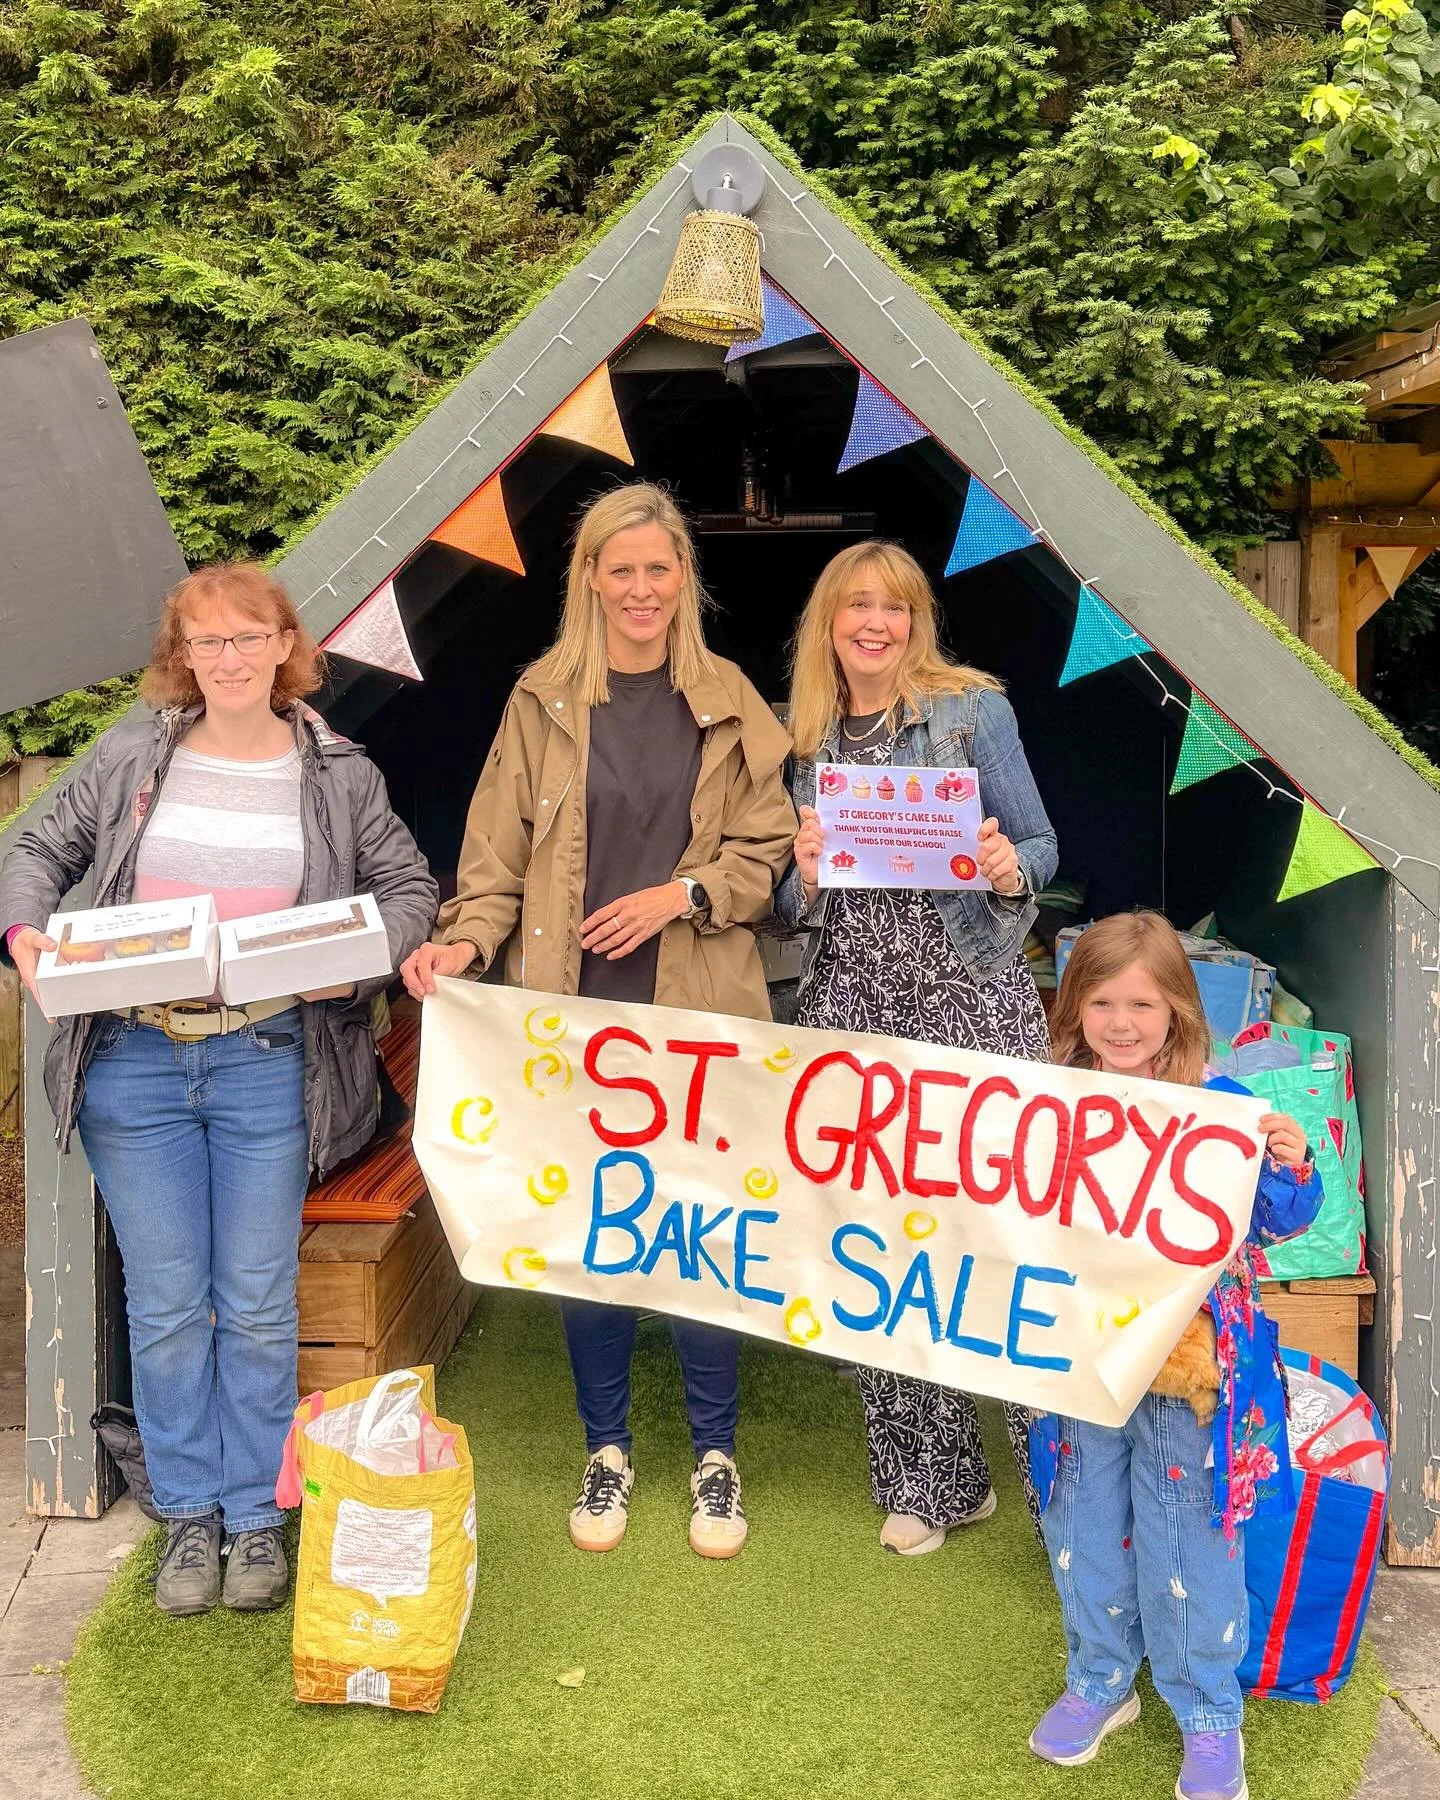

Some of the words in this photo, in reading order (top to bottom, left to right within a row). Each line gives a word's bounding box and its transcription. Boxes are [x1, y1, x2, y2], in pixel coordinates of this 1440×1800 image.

[839, 809, 849, 819] ST
[851, 810, 904, 821] GREGORY'S
[905, 812, 930, 822] CAKE
[931, 813, 955, 824] SALE
[834, 824, 860, 832] THANK
[861, 825, 877, 834] YOU
[878, 826, 894, 835] FOR
[894, 827, 928, 836] HELPING
[939, 829, 963, 838] RAISE
[854, 837, 879, 845] FUNDS
[880, 838, 895, 846] FOR
[895, 839, 912, 848] OUR
[913, 840, 947, 849] SCHOOL!
[584, 1026, 739, 1153] ST.
[785, 1051, 1256, 1267] GREGORY'S
[583, 1150, 786, 1305] BAKE
[832, 1223, 1077, 1372] SALE
